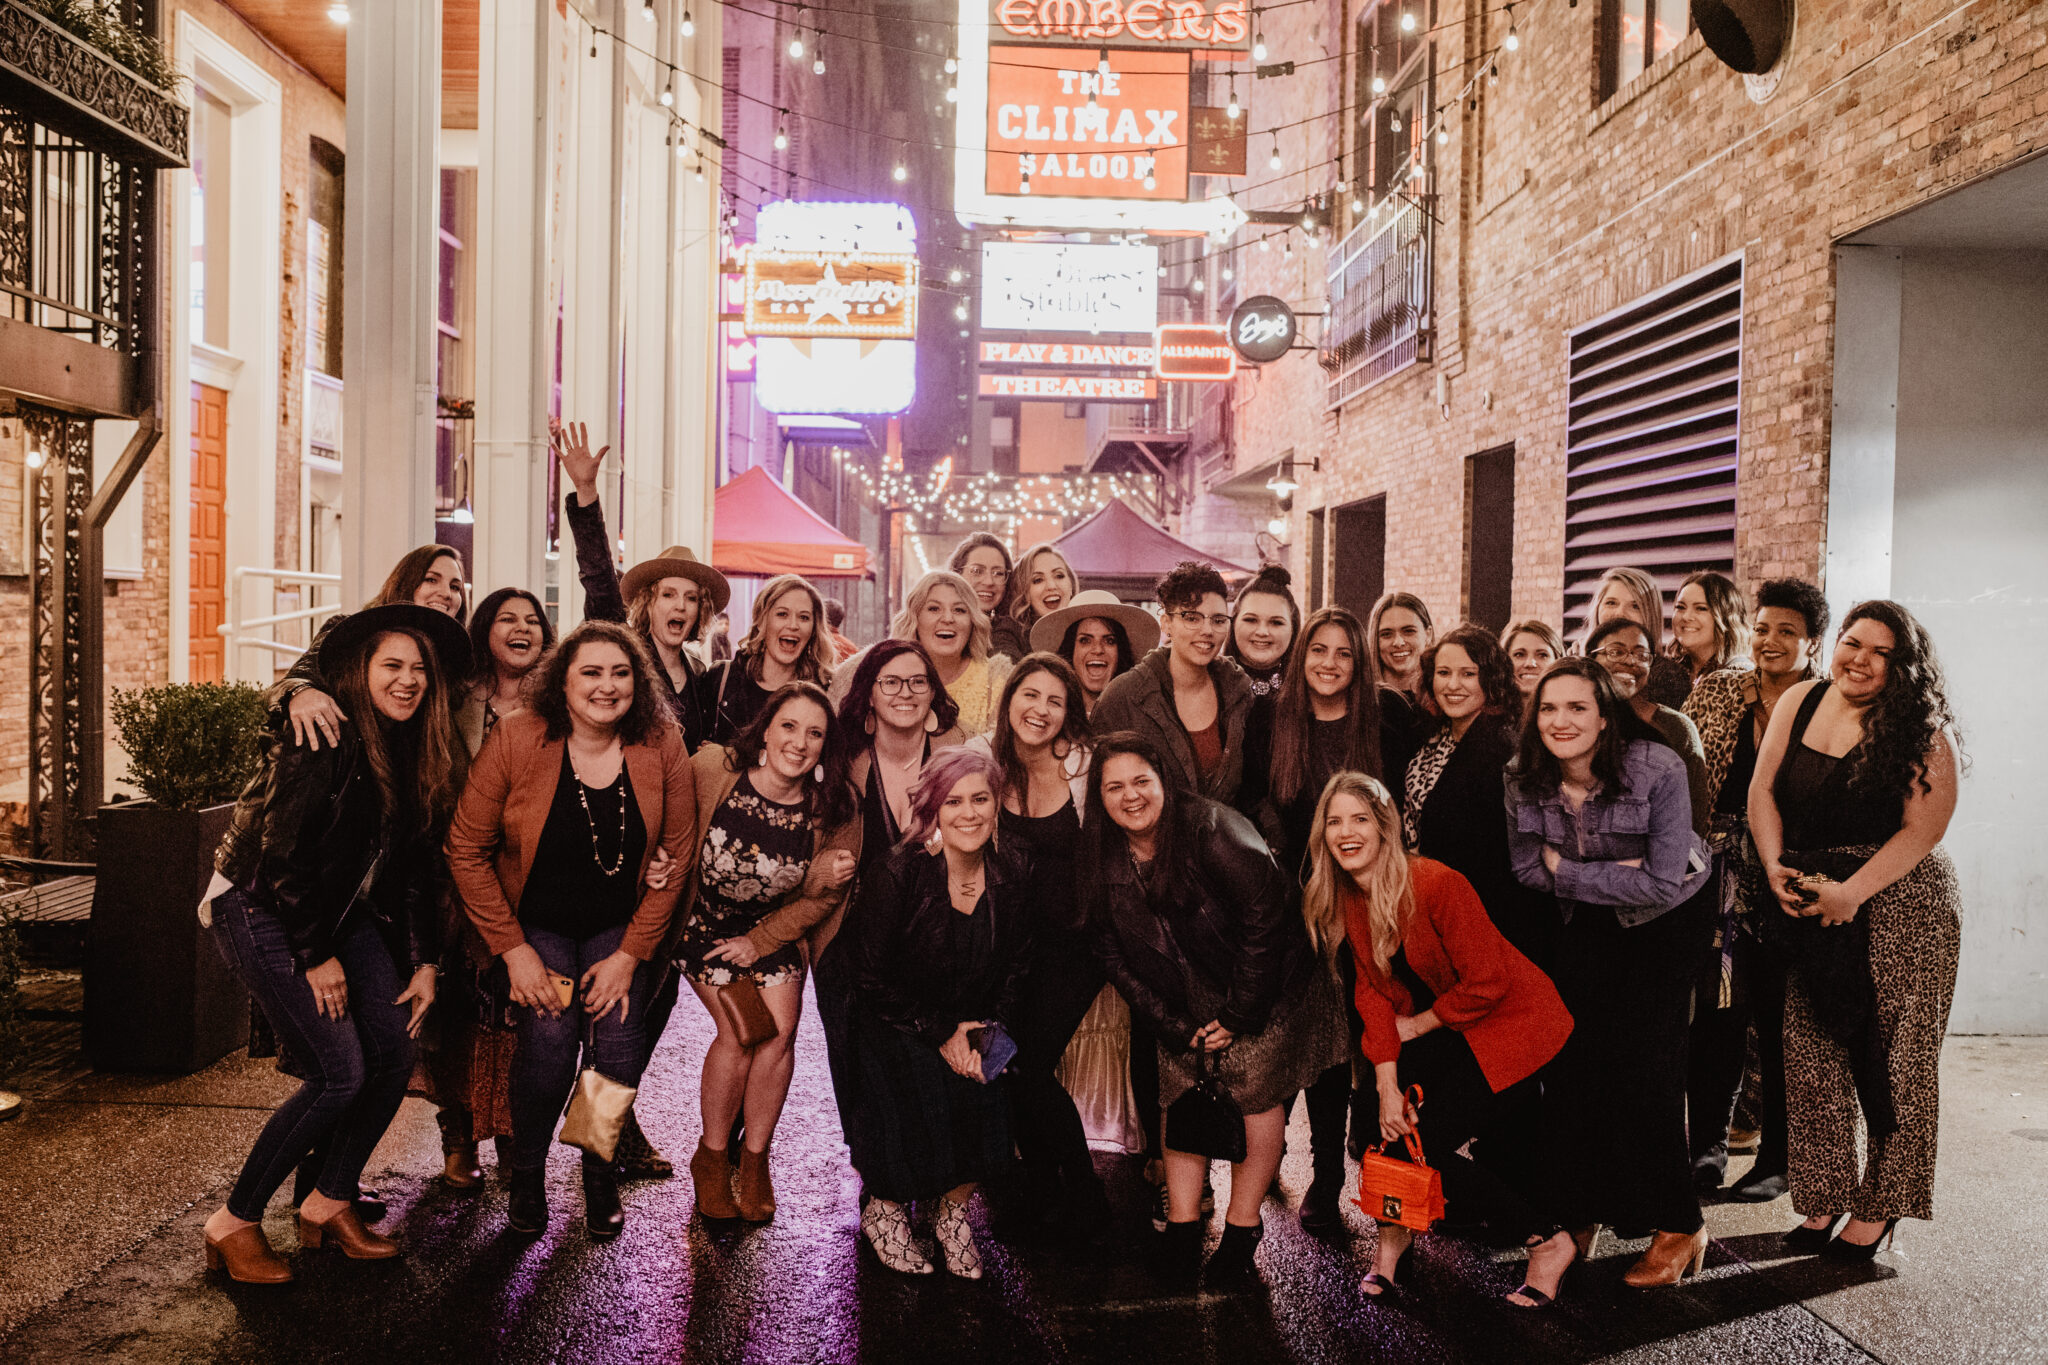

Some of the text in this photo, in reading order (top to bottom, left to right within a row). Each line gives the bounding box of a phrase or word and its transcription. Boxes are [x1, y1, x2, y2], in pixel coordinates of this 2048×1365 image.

[993, 0, 1250, 45] EMBERS
[1057, 70, 1121, 96] THE
[998, 103, 1178, 145] CLIMAX
[1019, 153, 1156, 182] SALOON
[770, 303, 886, 314] KAKE
[985, 343, 1155, 366] PLAY & DANCE
[1161, 345, 1232, 359] ALLSAINTS
[992, 376, 1145, 398] THEATRE
